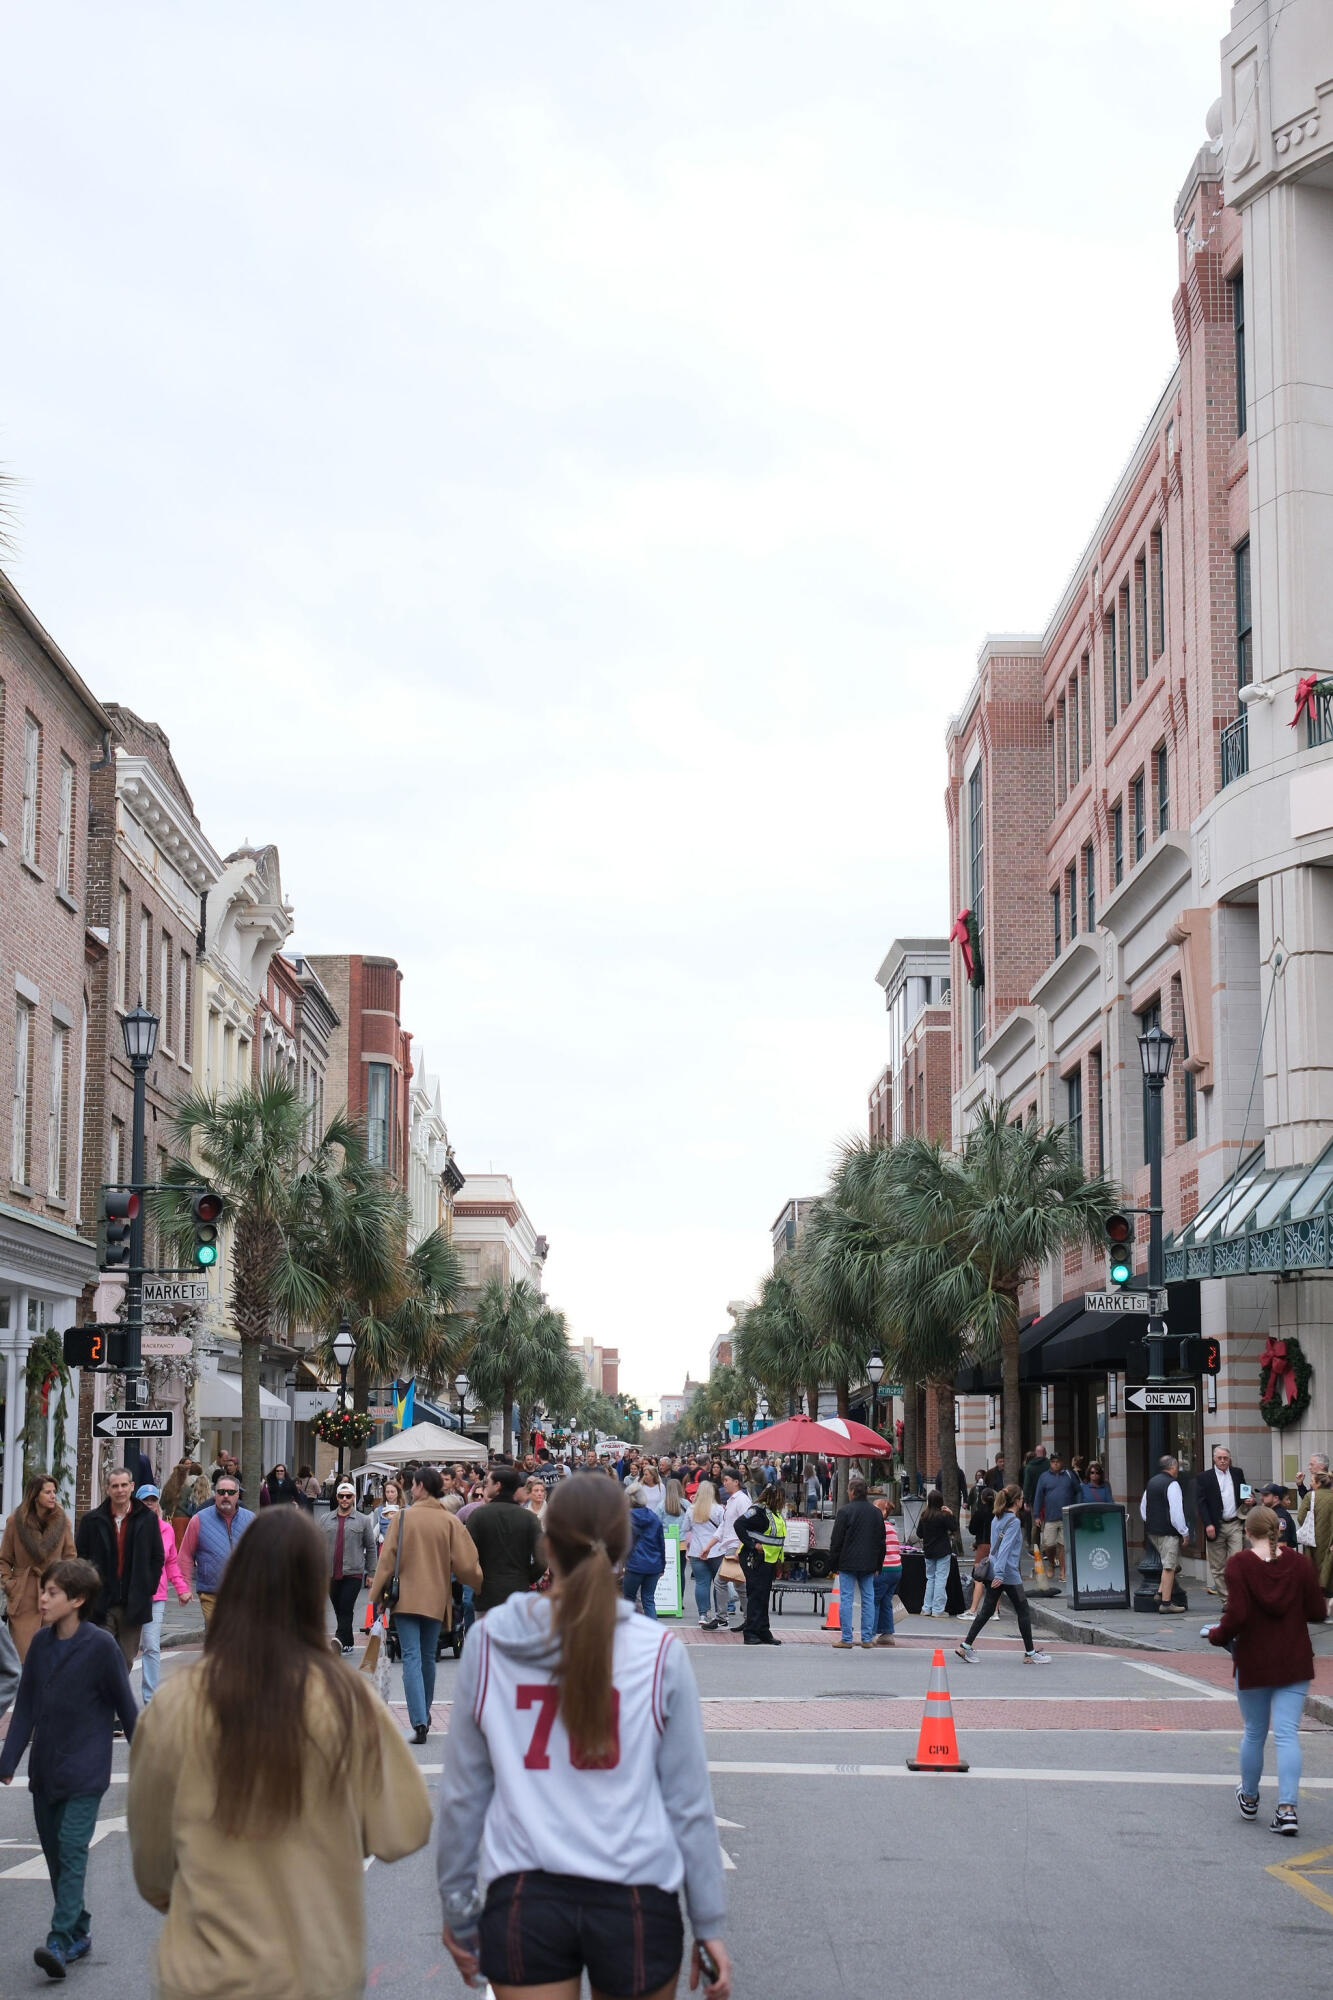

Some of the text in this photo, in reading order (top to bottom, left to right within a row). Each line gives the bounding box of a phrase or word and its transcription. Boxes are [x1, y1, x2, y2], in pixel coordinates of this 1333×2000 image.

[145, 1285, 206, 1299] MARKET ST
[1087, 1296, 1146, 1310] MARKET ST
[91, 1337, 101, 1359] 2
[1208, 1346, 1217, 1368] 2
[1145, 1394, 1188, 1403] ONE WAY
[116, 1419, 164, 1430] ONE WAY
[928, 1745, 949, 1755] CPD
